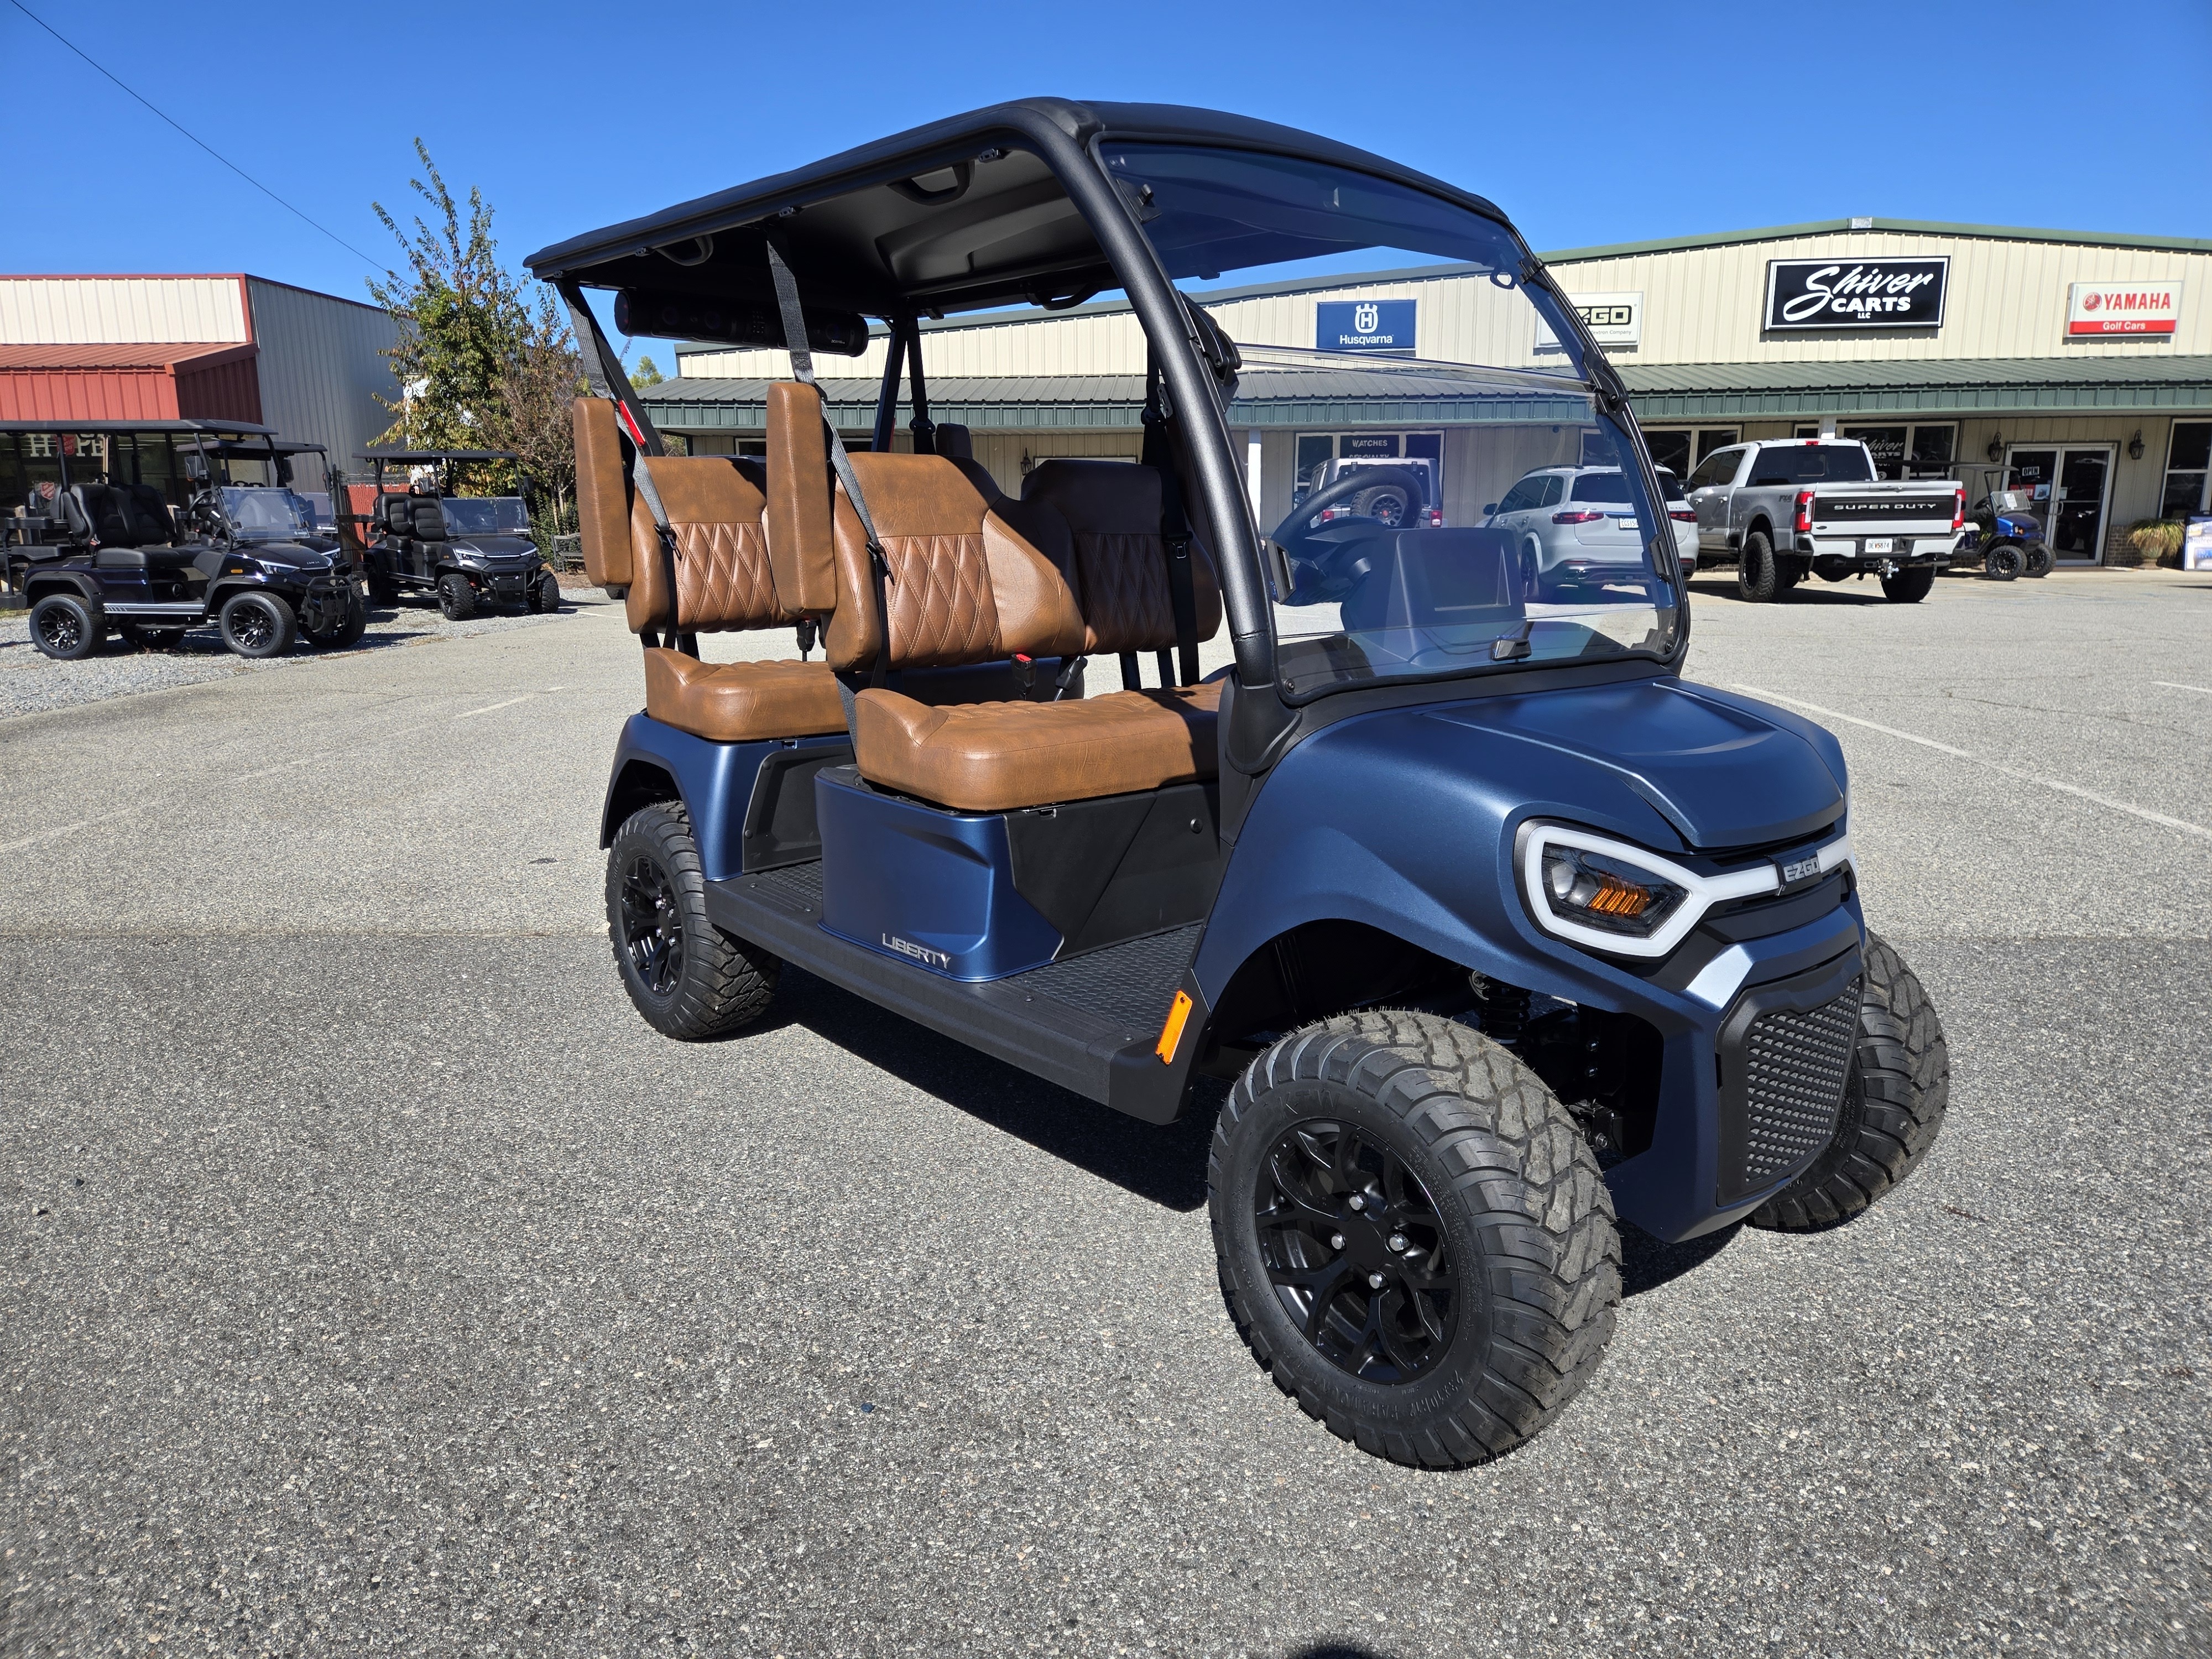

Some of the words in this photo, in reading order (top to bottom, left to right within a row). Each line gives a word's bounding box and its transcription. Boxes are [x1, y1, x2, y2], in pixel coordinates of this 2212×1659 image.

[1783, 265, 1934, 321] Shiver
[2104, 293, 2171, 310] YAMAHA
[1831, 297, 1911, 312] CARTS
[1576, 307, 1629, 325] ZGO
[2103, 321, 2121, 330] Golf
[2124, 321, 2146, 330] Cars
[1340, 335, 1392, 346] Husqvarna
[2024, 467, 2038, 475] OPEN
[1784, 857, 1820, 882] EZGO
[882, 933, 951, 969] LIBERTY
